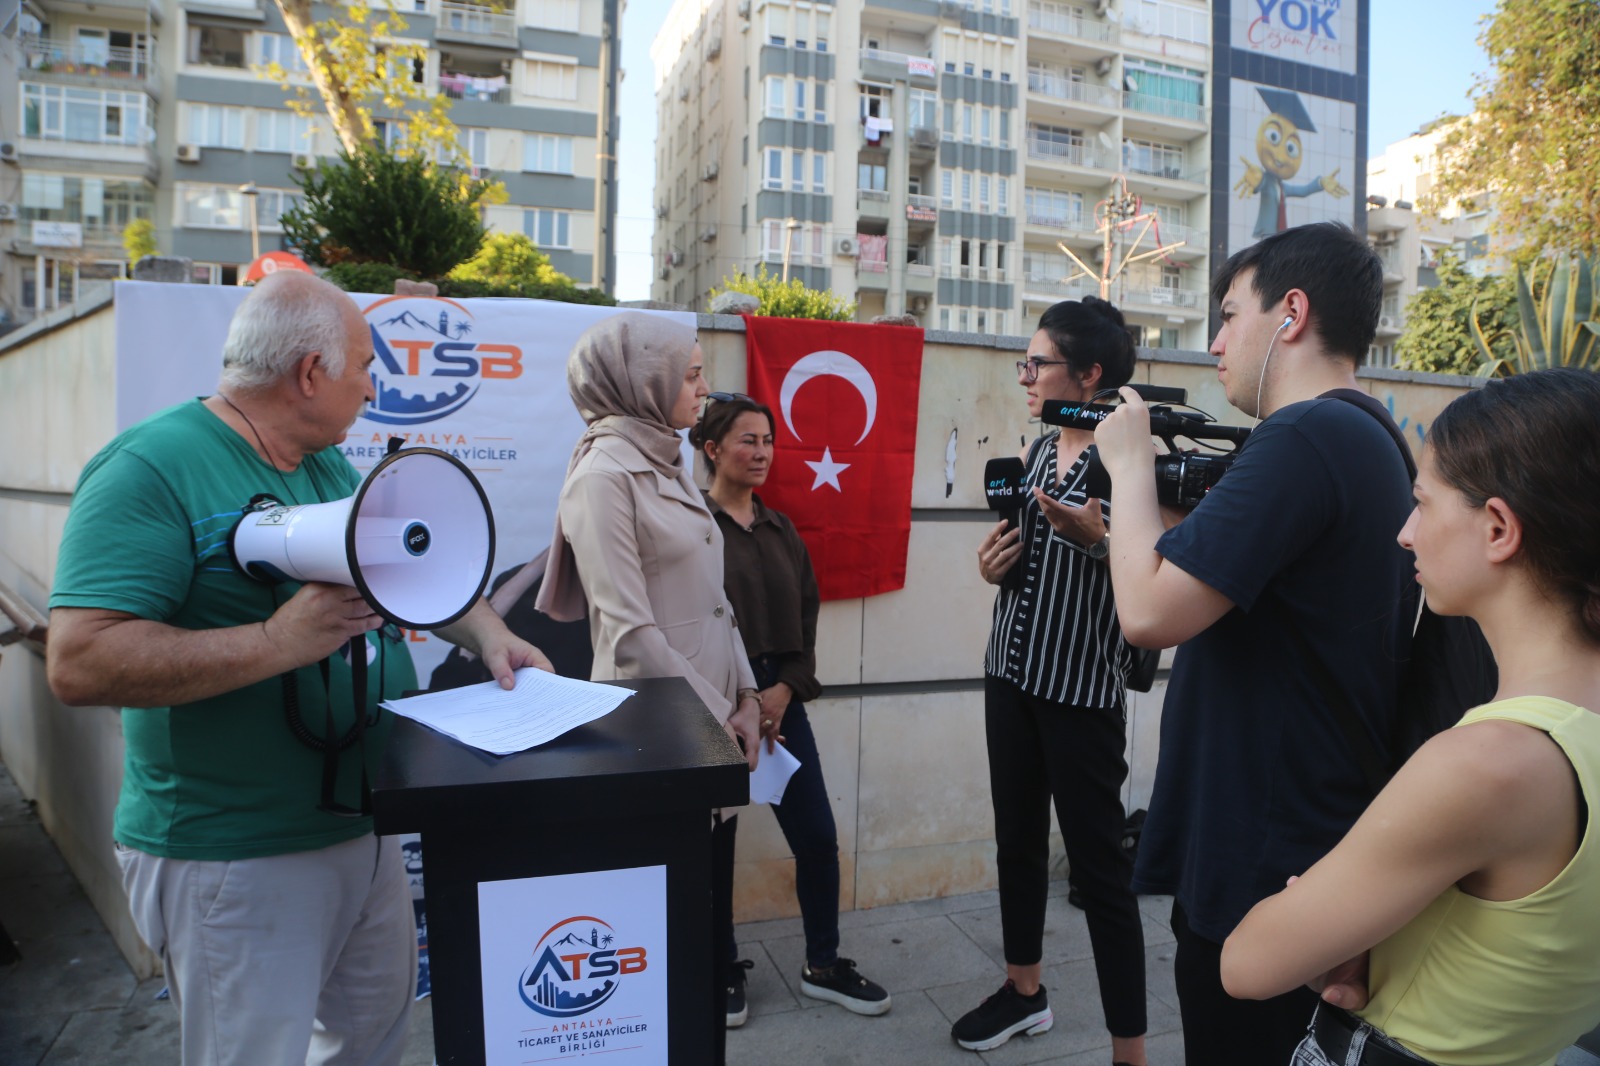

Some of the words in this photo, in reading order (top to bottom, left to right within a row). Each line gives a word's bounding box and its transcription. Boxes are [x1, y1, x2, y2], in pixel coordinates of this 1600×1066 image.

[1256, 0, 1337, 40] YOK
[1060, 406, 1081, 417] art
[990, 477, 1006, 488] art
[987, 486, 1013, 496] world
[525, 945, 648, 986] ATSB
[552, 1017, 613, 1033] ANTALYA
[518, 1035, 563, 1048] TİCARET
[566, 1033, 579, 1042] VE
[582, 1023, 648, 1040] SANAYİCİLER
[560, 1039, 606, 1053] BİRLİĞİ
